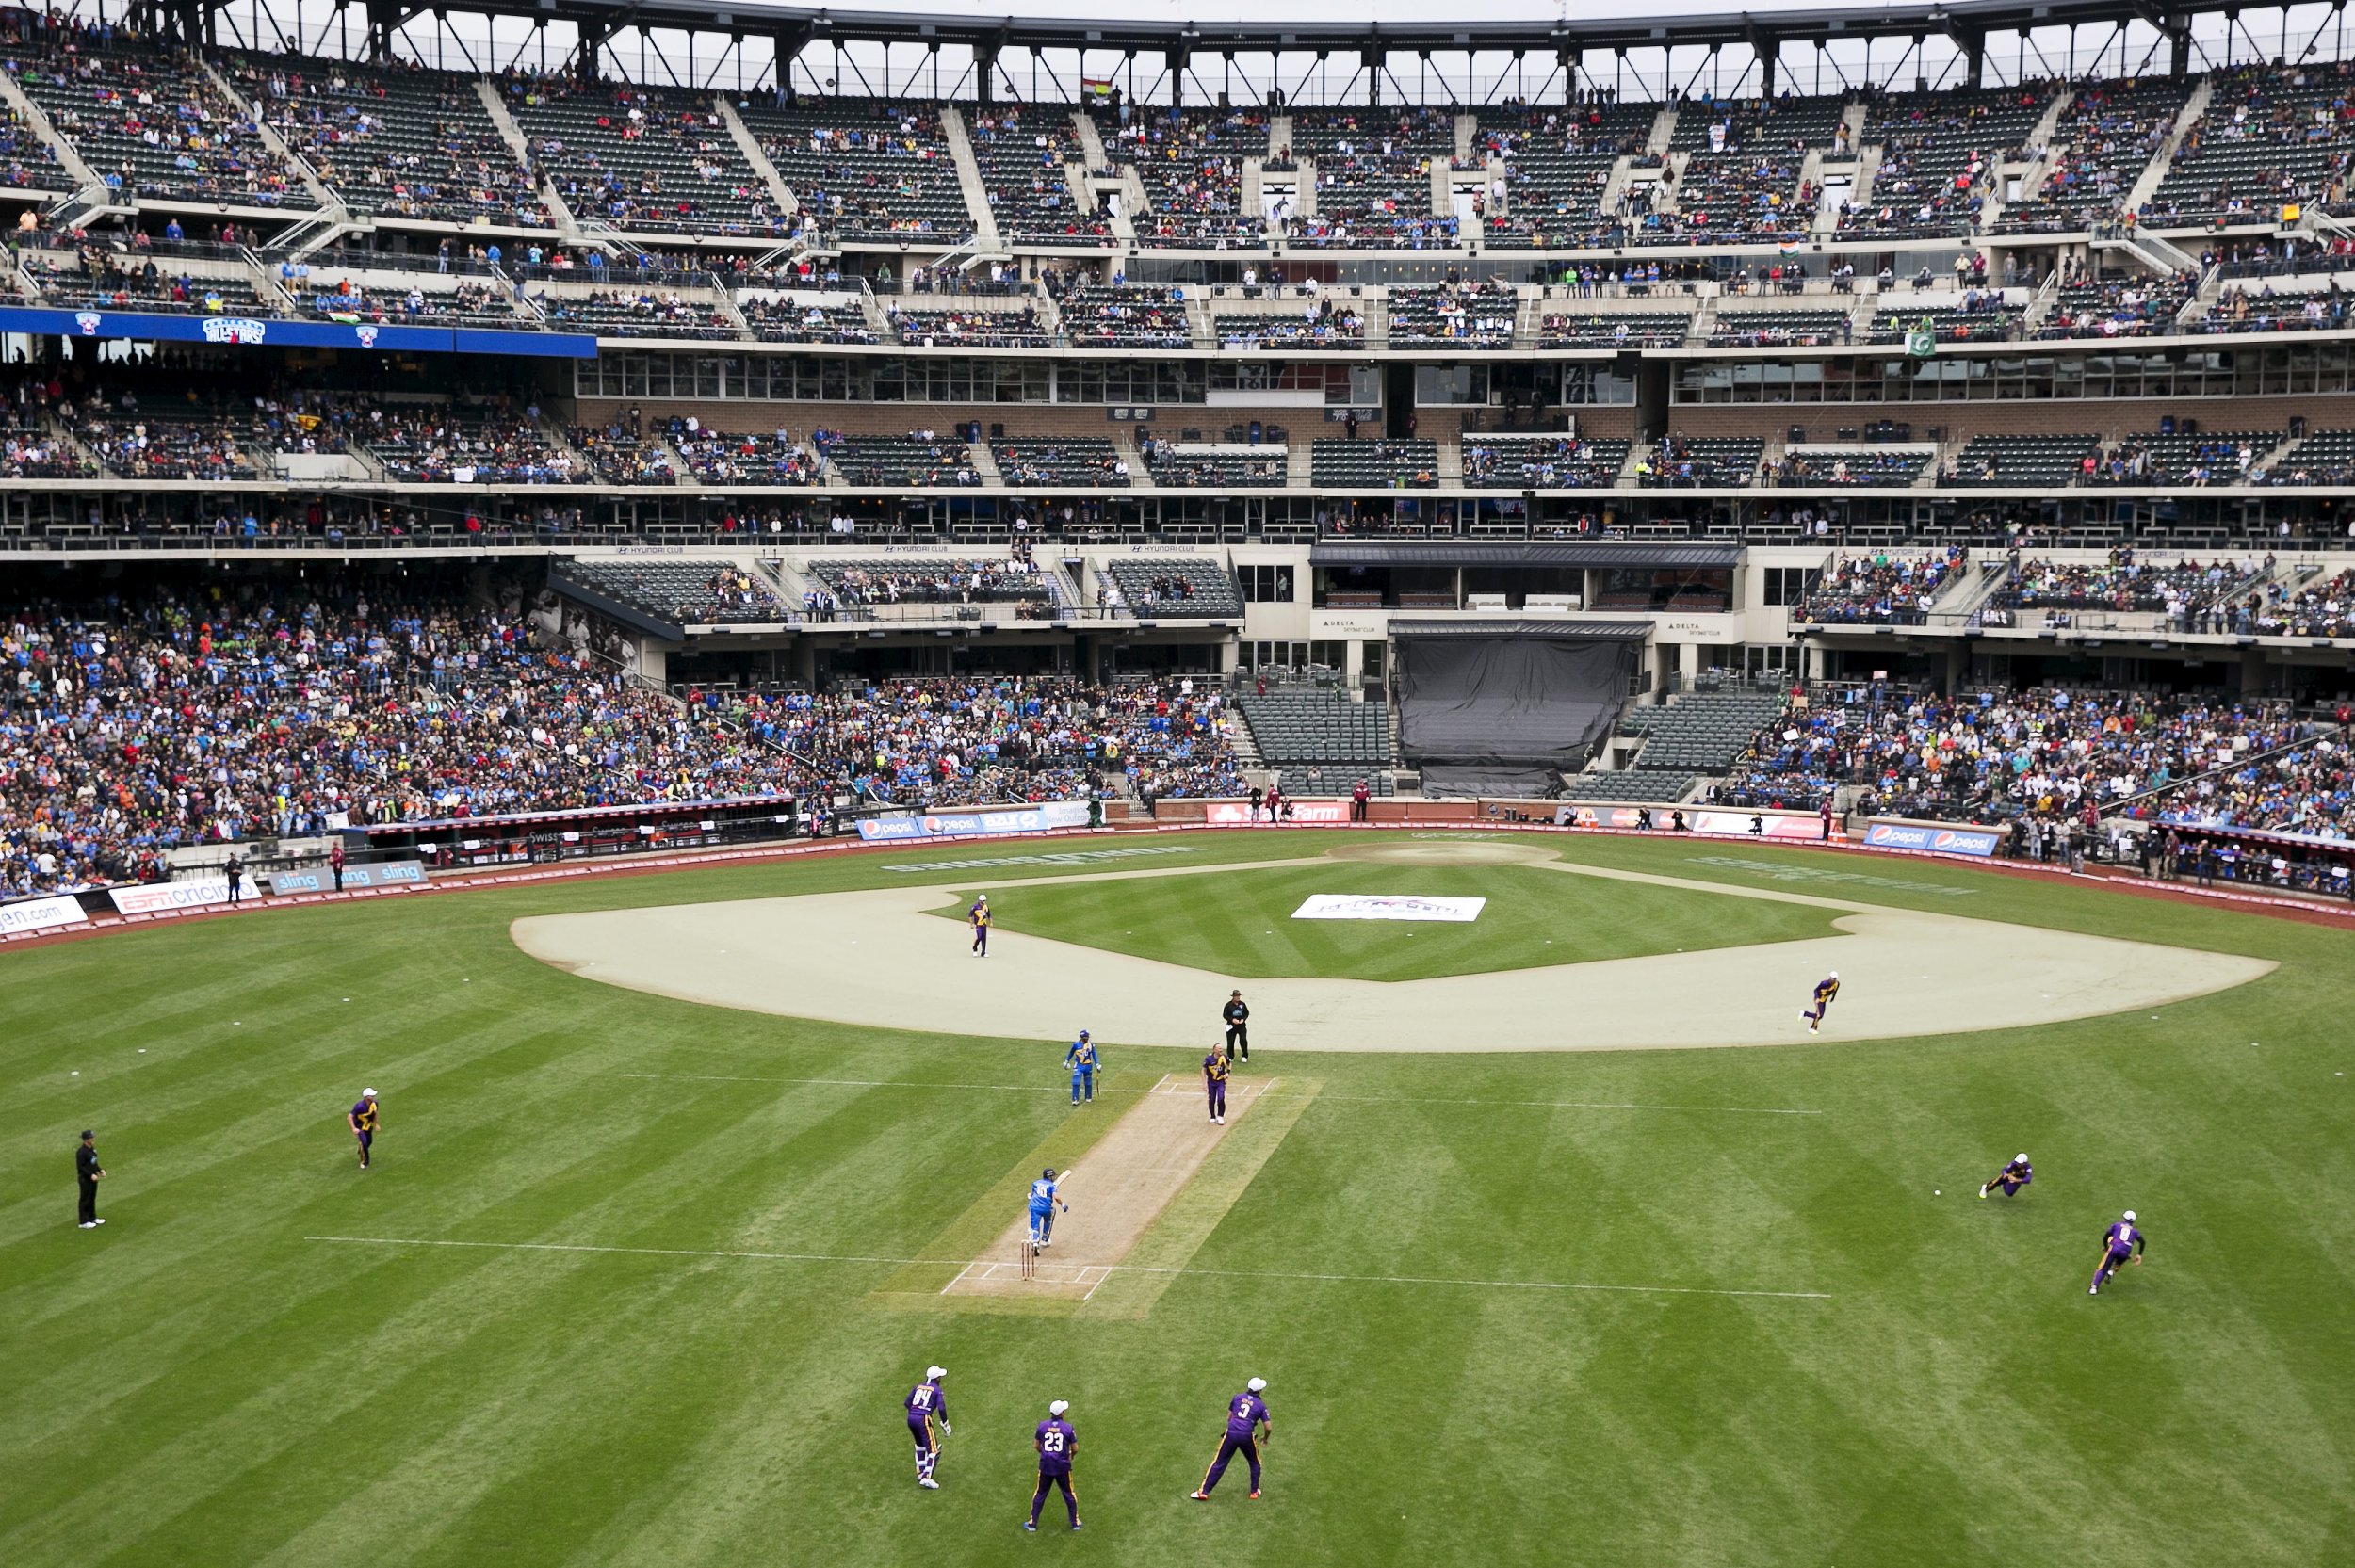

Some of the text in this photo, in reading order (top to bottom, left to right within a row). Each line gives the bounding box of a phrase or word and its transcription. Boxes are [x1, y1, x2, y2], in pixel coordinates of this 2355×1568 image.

[1294, 804, 1339, 820] Farm
[882, 821, 914, 835] pepsi
[944, 817, 976, 832] pepsi
[1890, 832, 1925, 844] pepsi
[1954, 837, 1990, 850] pepsi
[382, 863, 420, 882] sling
[278, 873, 319, 890] sling
[913, 1389, 933, 1407] 84
[1237, 1403, 1251, 1418] 3
[1044, 1431, 1064, 1452] 23
